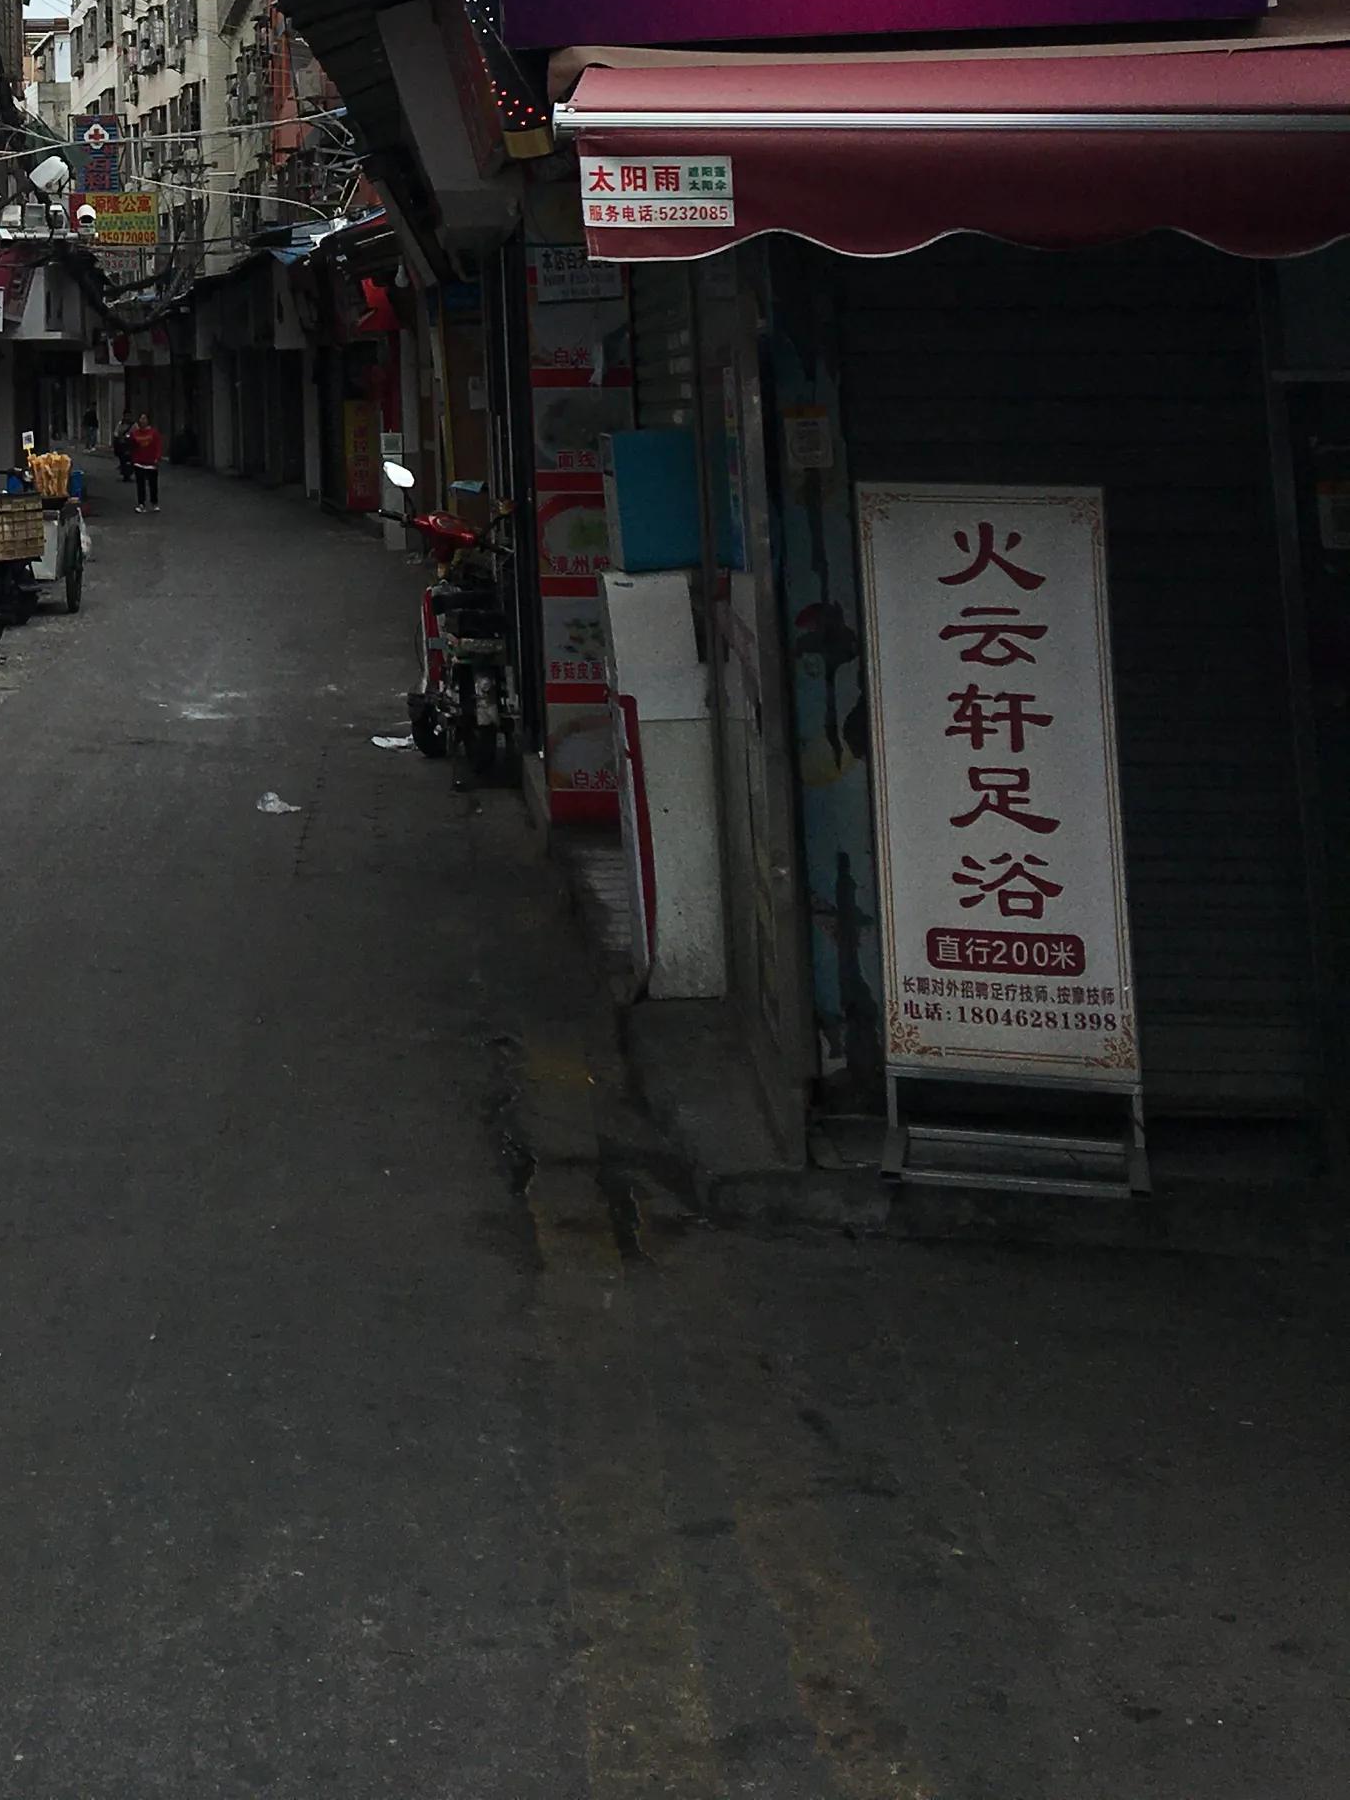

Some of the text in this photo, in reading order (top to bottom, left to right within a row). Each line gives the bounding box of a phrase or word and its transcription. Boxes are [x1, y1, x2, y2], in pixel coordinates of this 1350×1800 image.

[588, 165, 682, 192] 太阳雨
[589, 204, 729, 223] 服务电话:5232085
[936, 521, 1065, 920] 火云轩足浴
[936, 935, 1077, 970] 直行200米
[902, 975, 1116, 1006] 长期对外招聘足疗技师、按摩技师
[903, 999, 1118, 1032] 电话:18046281398
